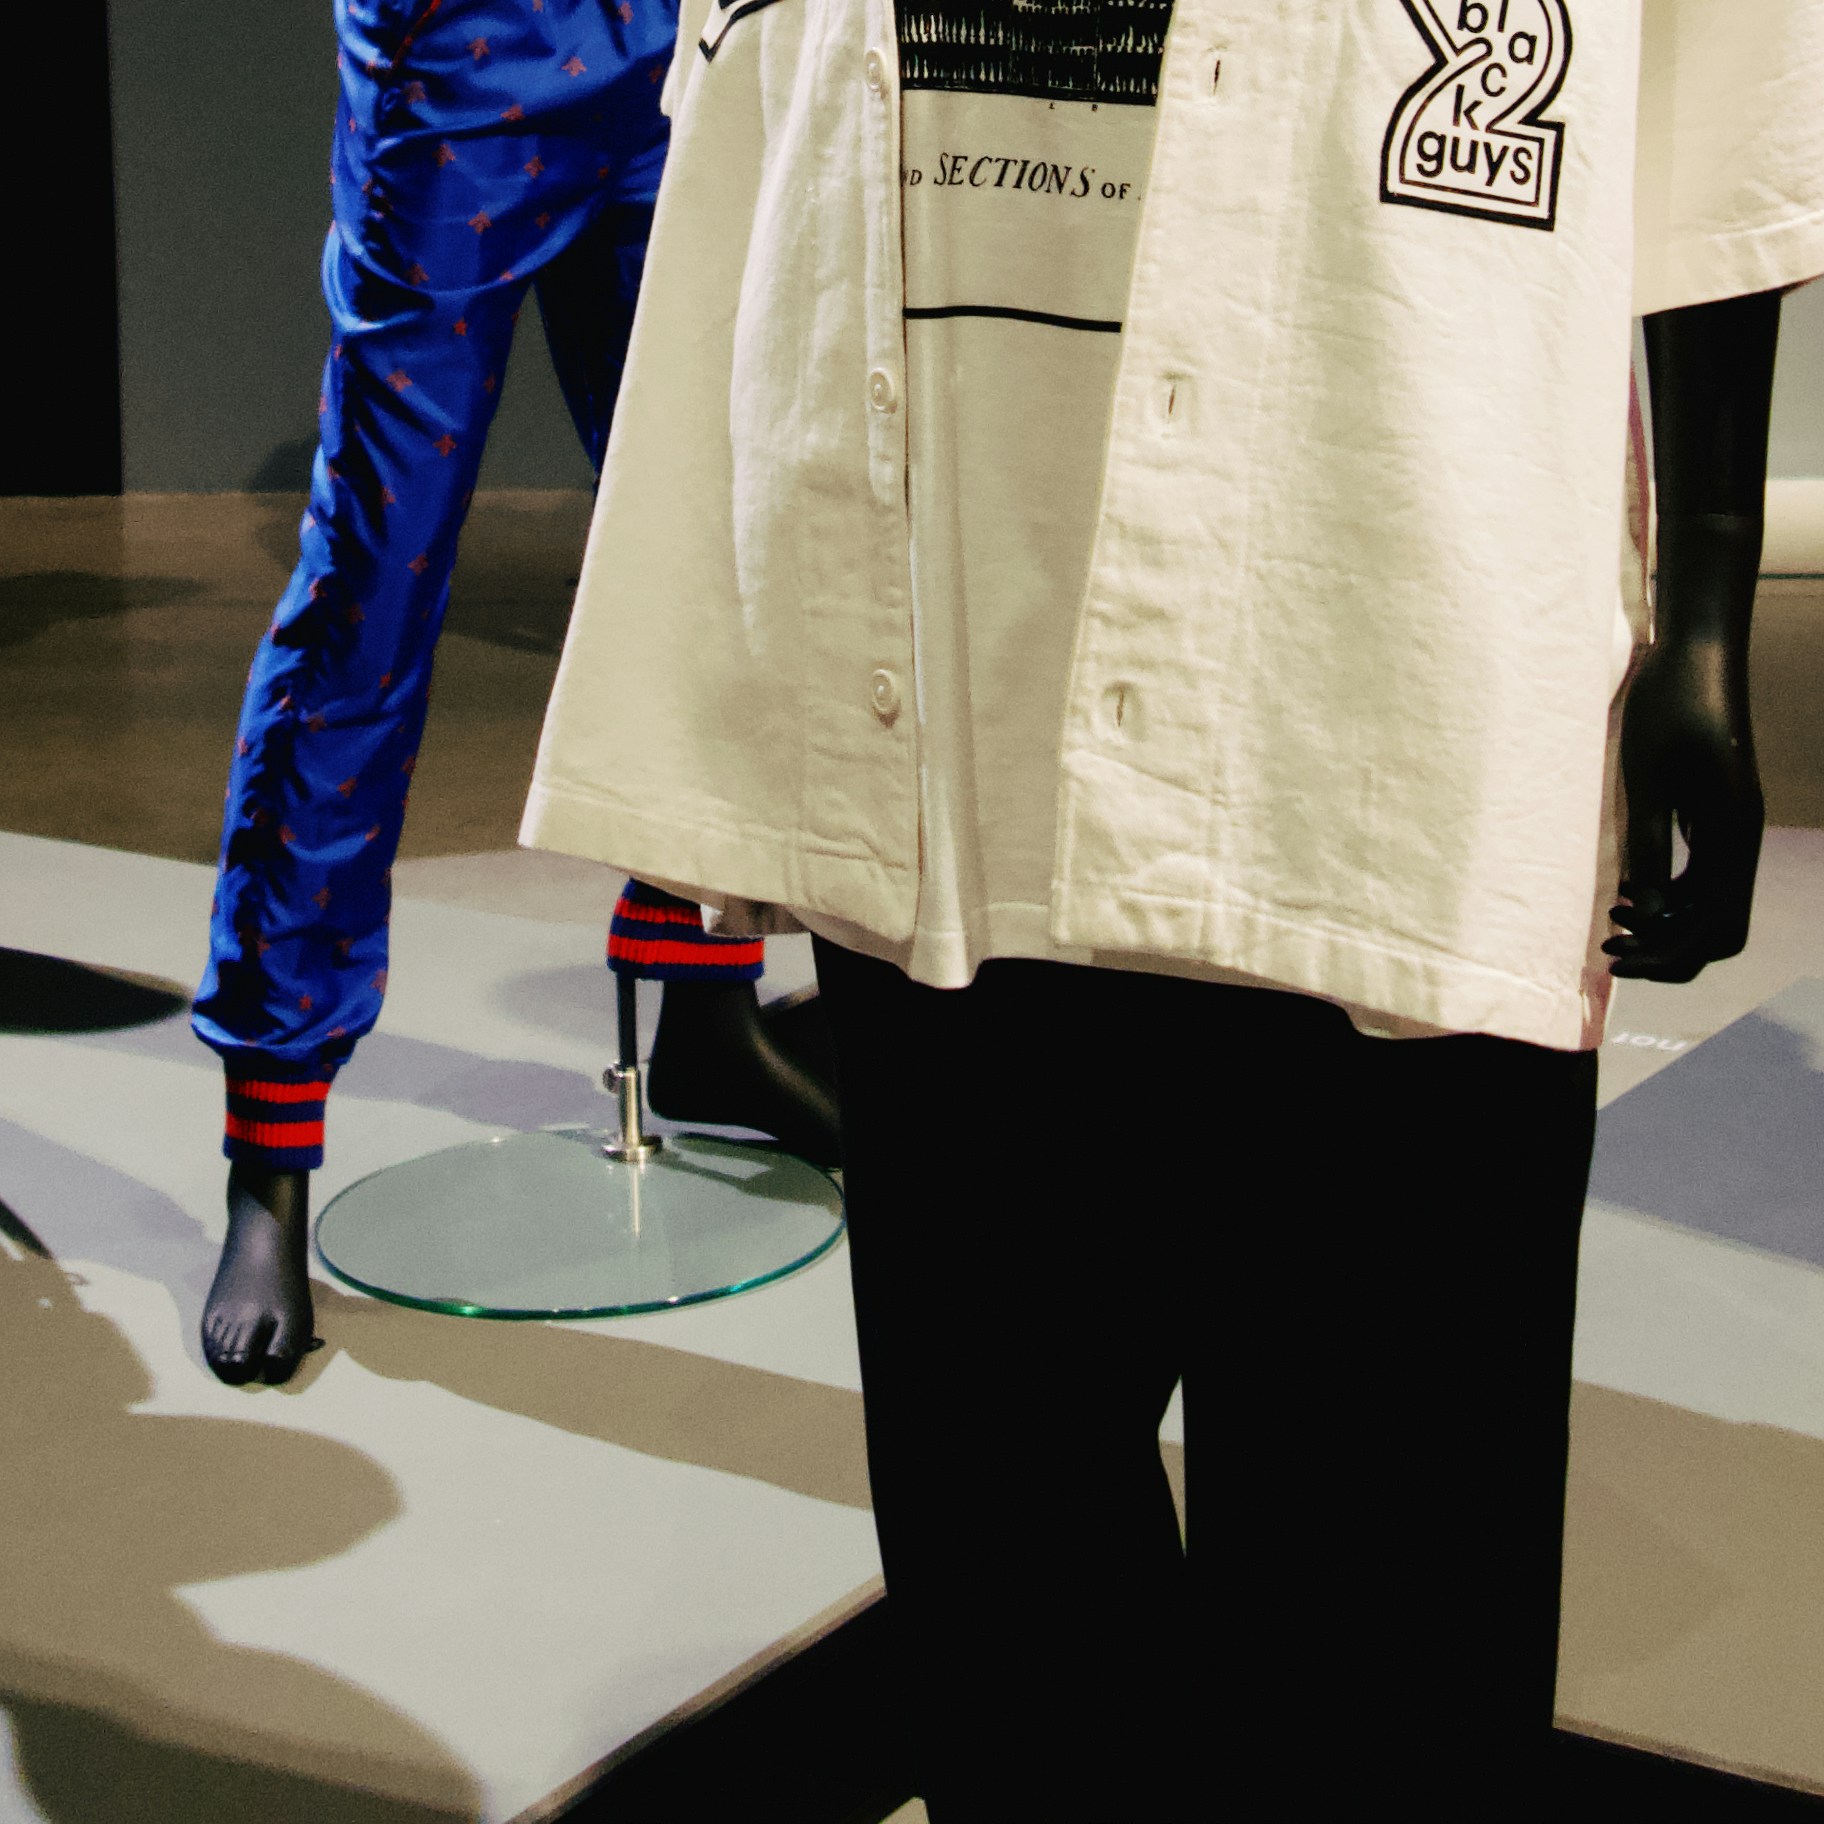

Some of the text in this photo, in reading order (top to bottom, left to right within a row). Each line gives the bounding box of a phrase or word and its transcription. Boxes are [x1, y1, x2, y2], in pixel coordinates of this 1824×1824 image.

[933, 152, 1091, 198] SECTIONS
[1101, 182, 1131, 200] OF
[1416, 130, 1533, 187] guys
